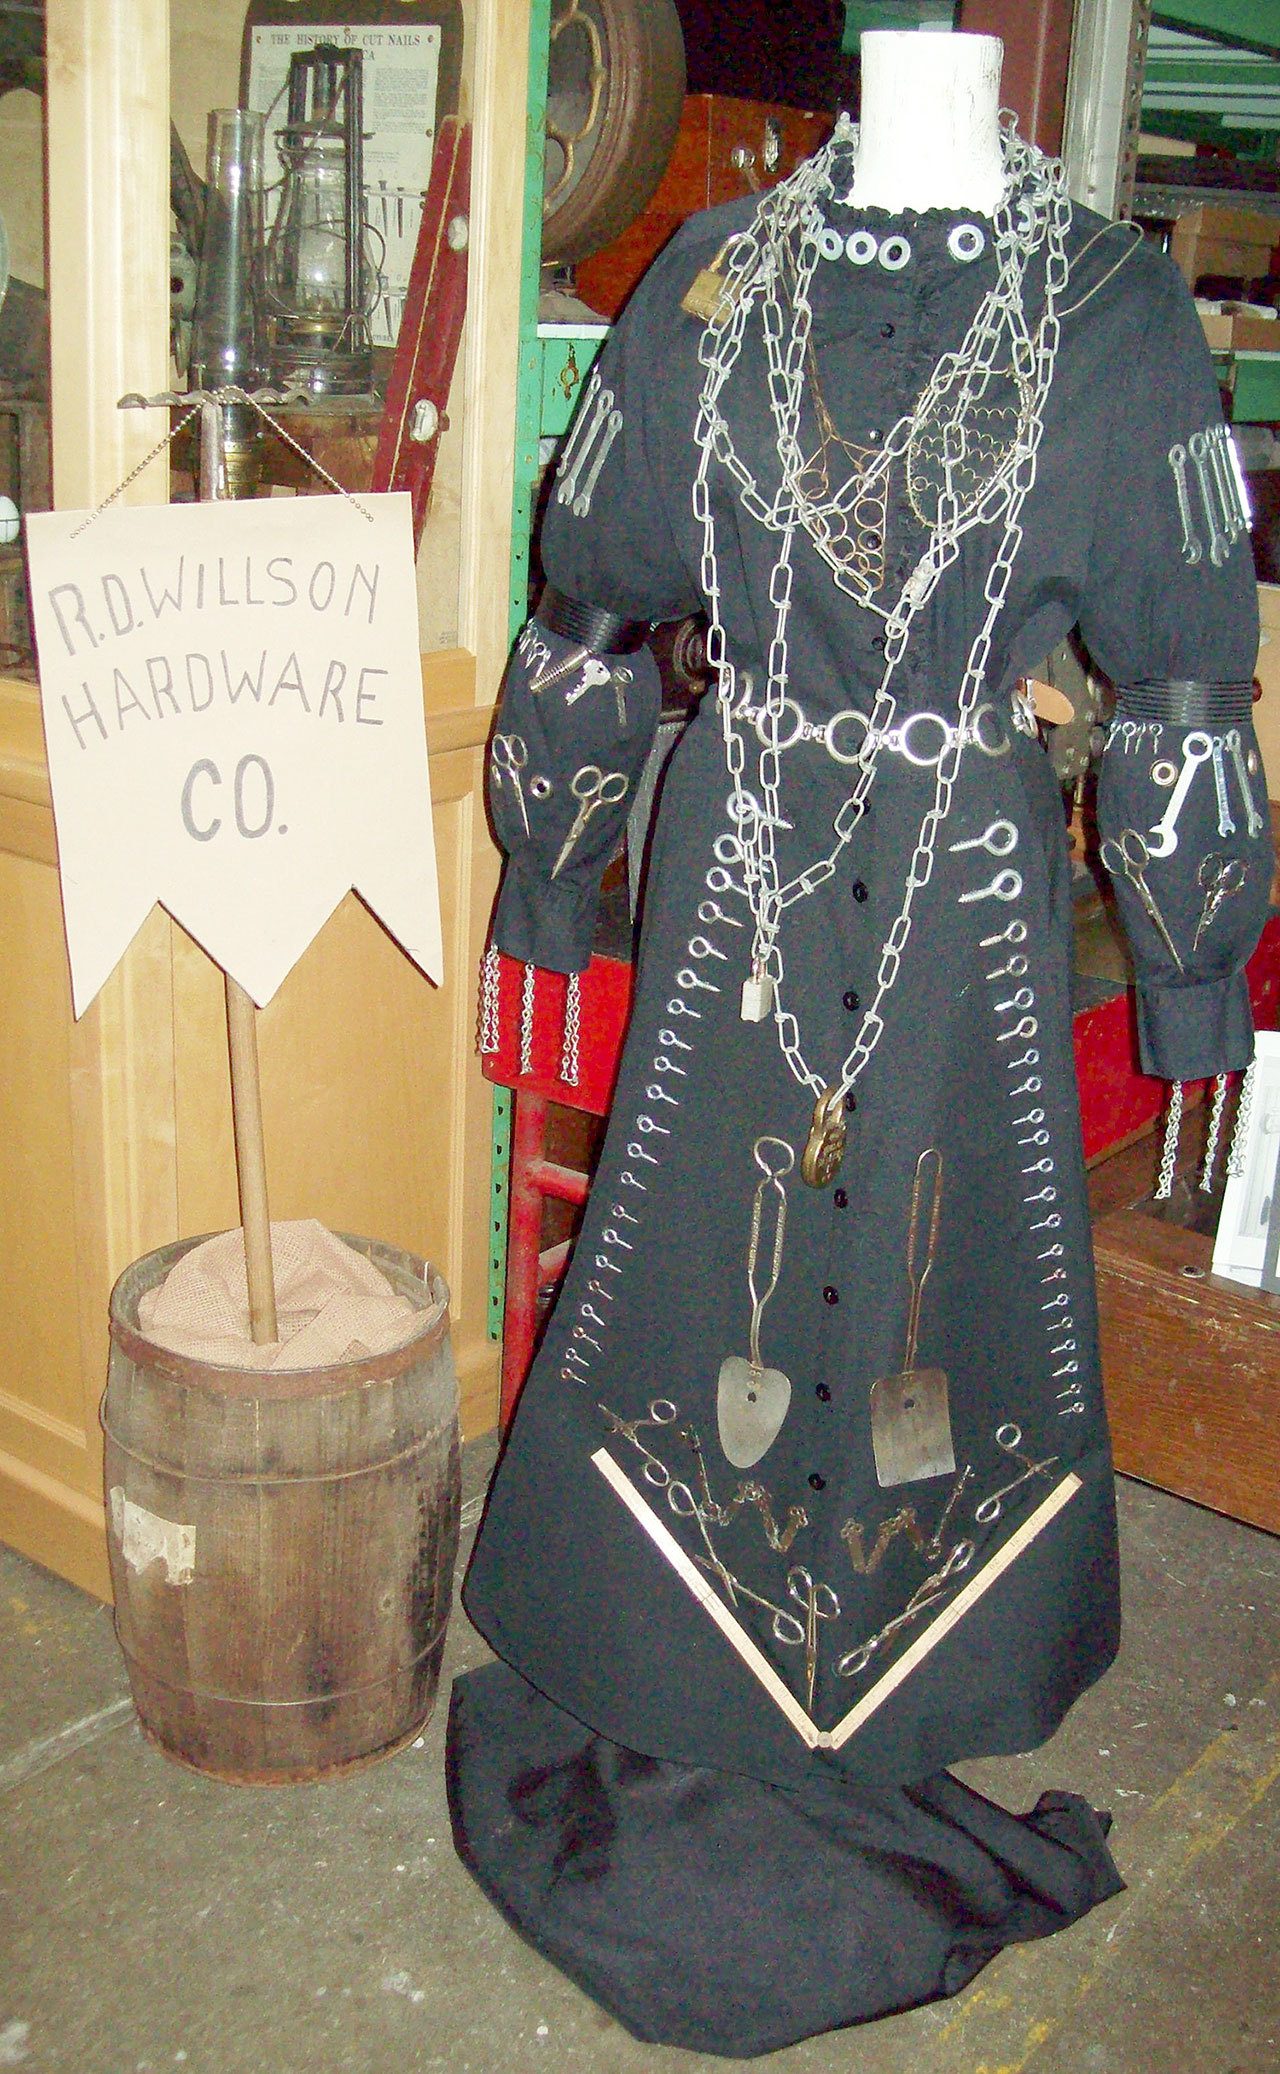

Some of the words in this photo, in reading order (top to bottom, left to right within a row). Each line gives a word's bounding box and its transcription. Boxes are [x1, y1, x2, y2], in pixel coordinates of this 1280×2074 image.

[271, 34, 290, 45] THE
[296, 34, 340, 45] HISTORY
[344, 34, 357, 45] OF
[362, 34, 384, 45] CUT
[388, 34, 421, 46] NAILS
[61, 650, 389, 750] HARDWARE
[180, 753, 289, 842] CO.
